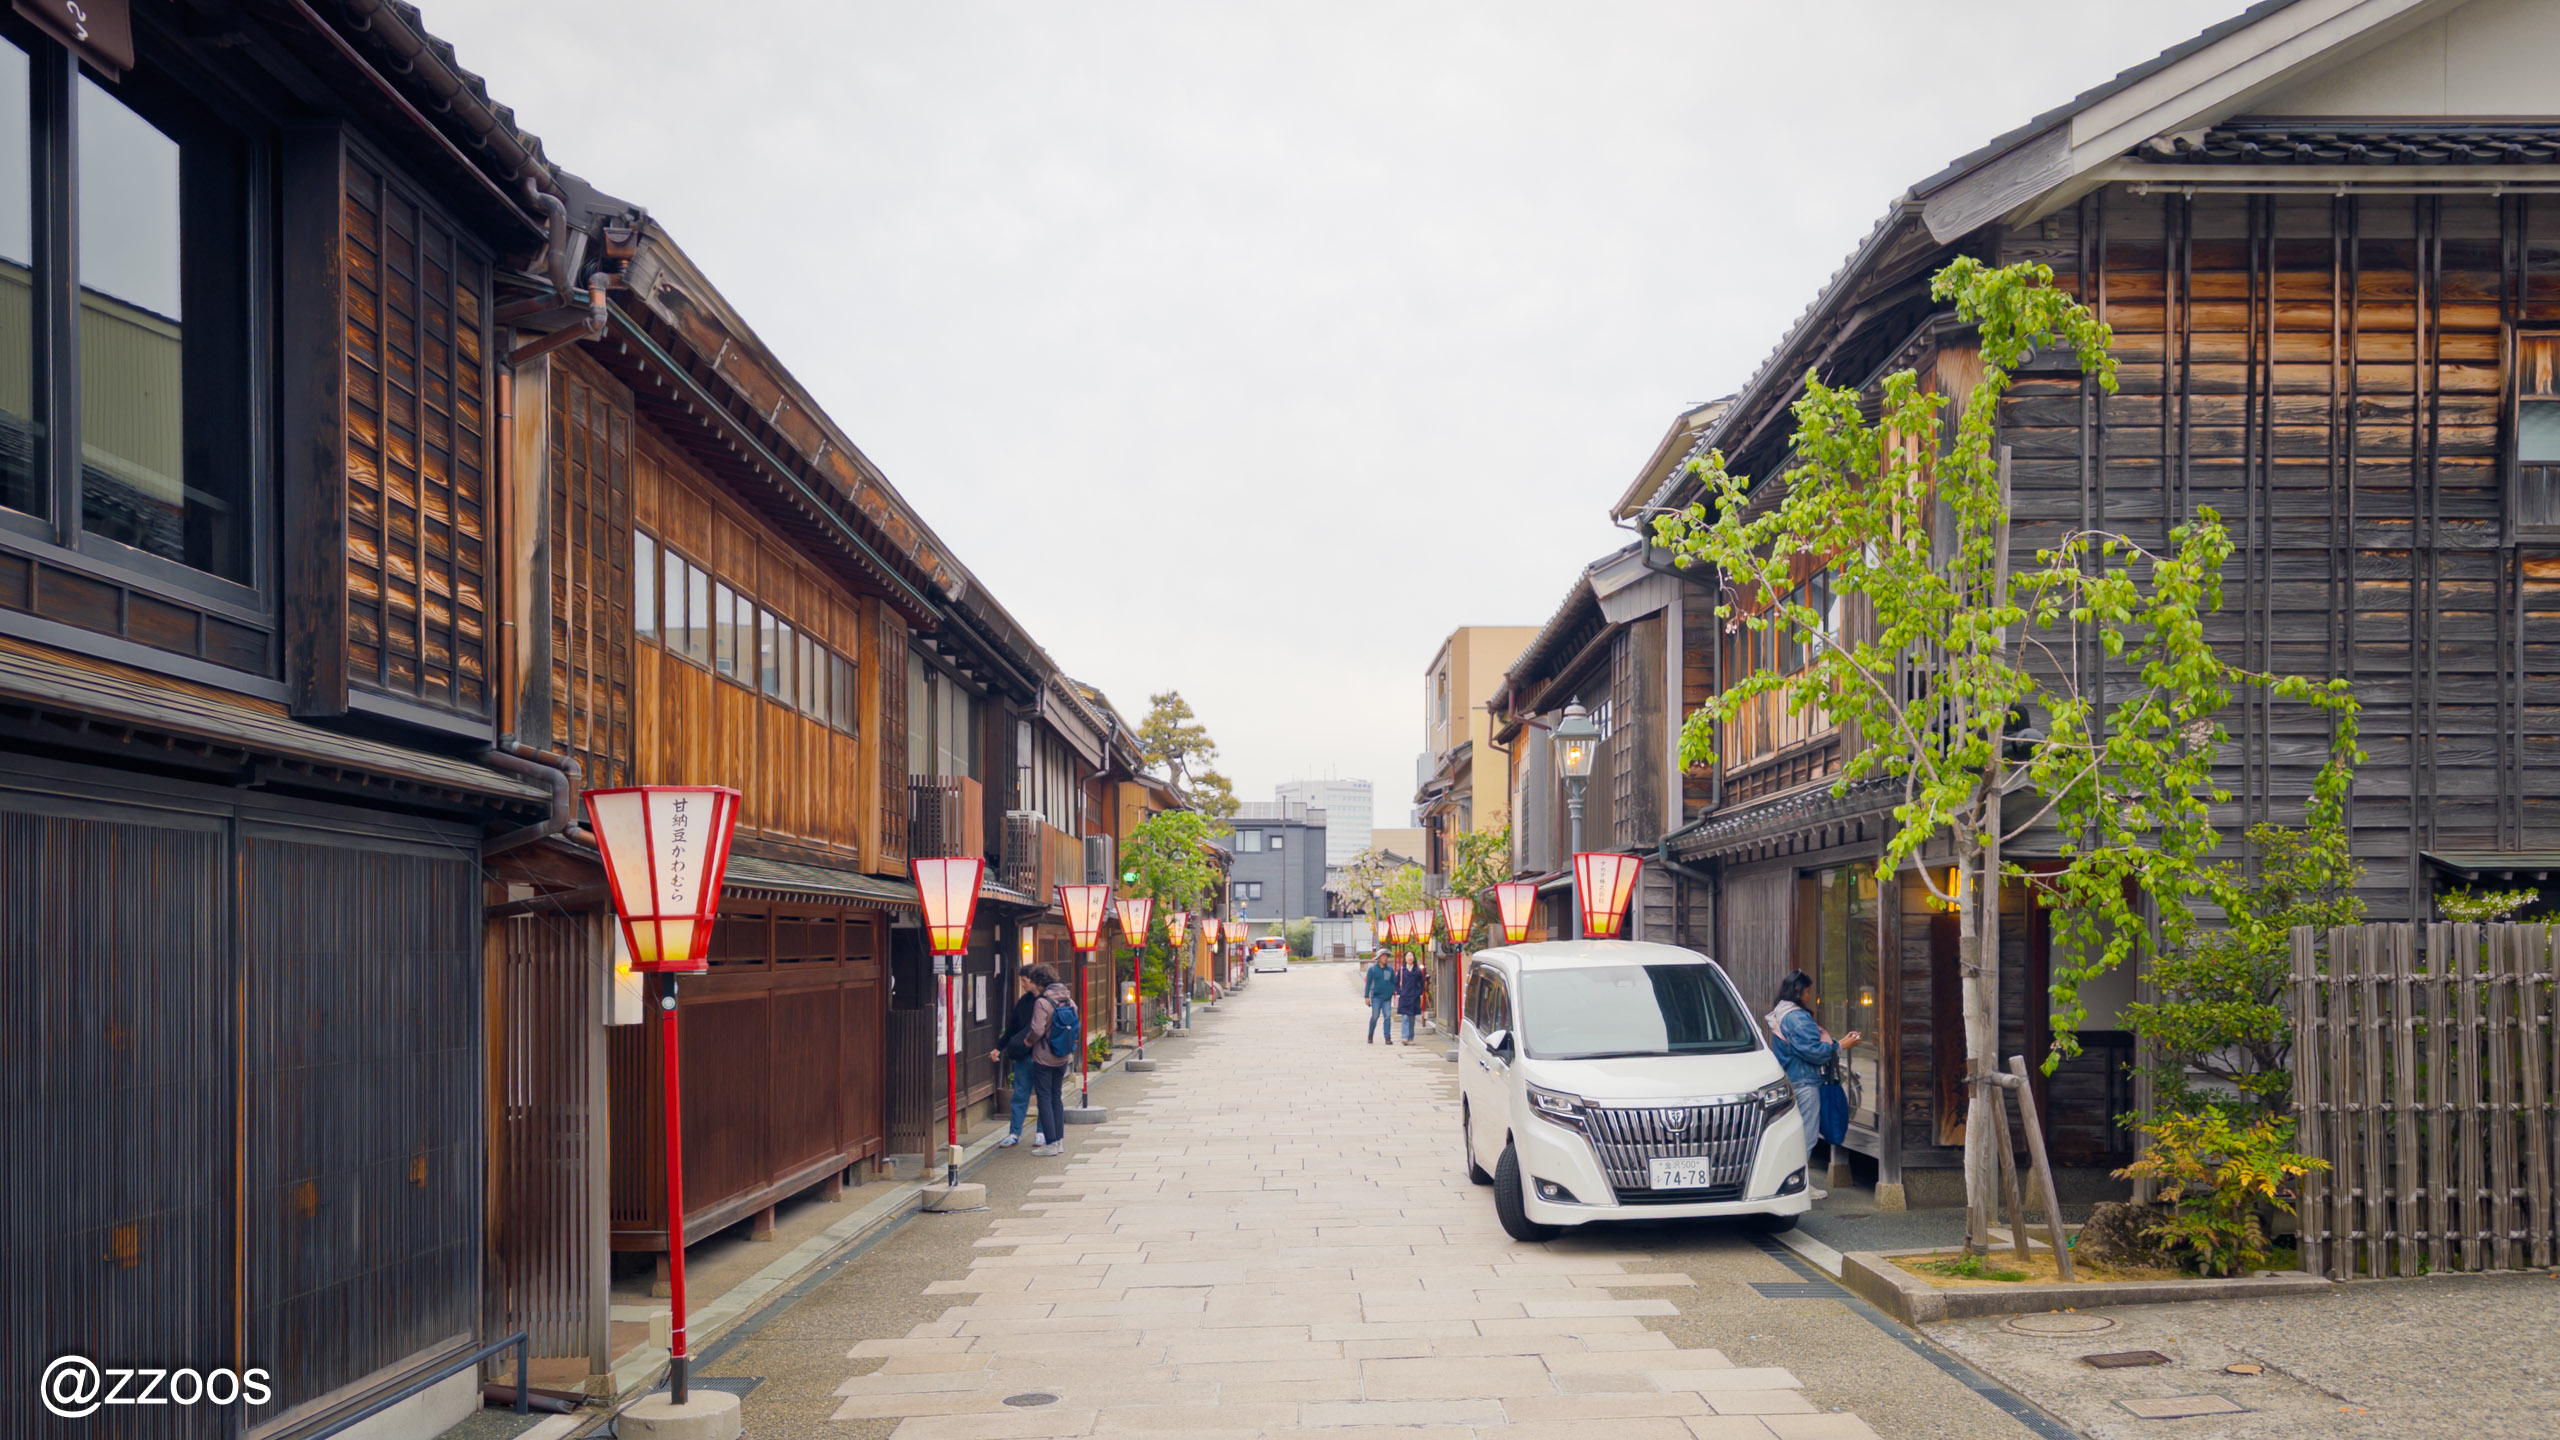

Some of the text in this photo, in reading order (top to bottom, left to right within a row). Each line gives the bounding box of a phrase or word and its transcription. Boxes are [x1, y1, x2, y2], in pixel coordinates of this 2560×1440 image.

[671, 797, 689, 903] 甘納豆かわむら
[1664, 1170, 1706, 1186] 74-78
